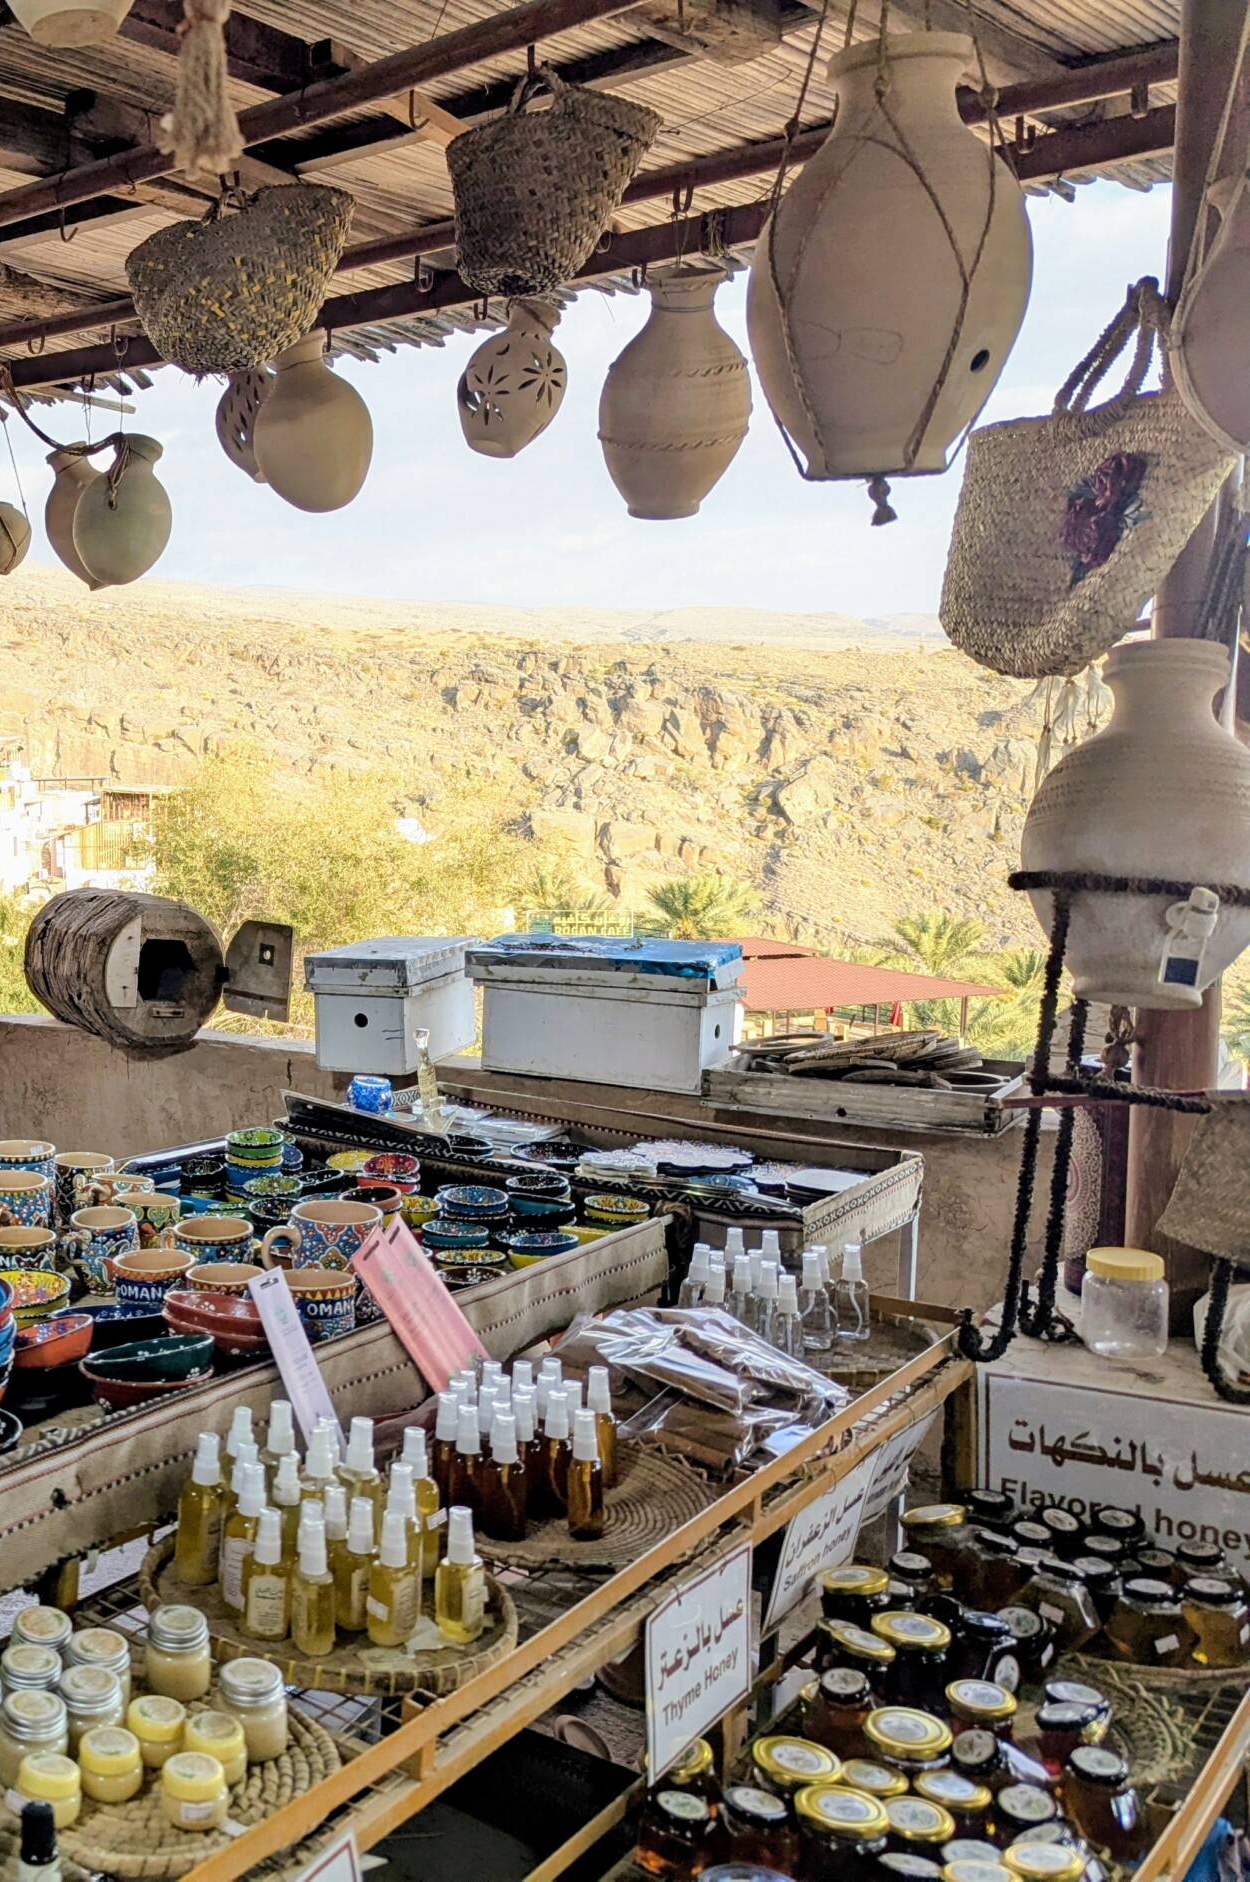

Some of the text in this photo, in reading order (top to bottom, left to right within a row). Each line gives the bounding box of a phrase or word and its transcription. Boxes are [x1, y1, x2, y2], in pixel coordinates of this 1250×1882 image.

[554, 926, 630, 936] ROGAN CAFE
[120, 1283, 163, 1300] OMAN
[306, 1299, 356, 1317] OMAN
[1008, 1418, 1164, 1488] بالنكهات
[783, 1523, 854, 1592] Saffron honey
[714, 1598, 745, 1644] عسل
[662, 1646, 739, 1727] Thyme Honey
